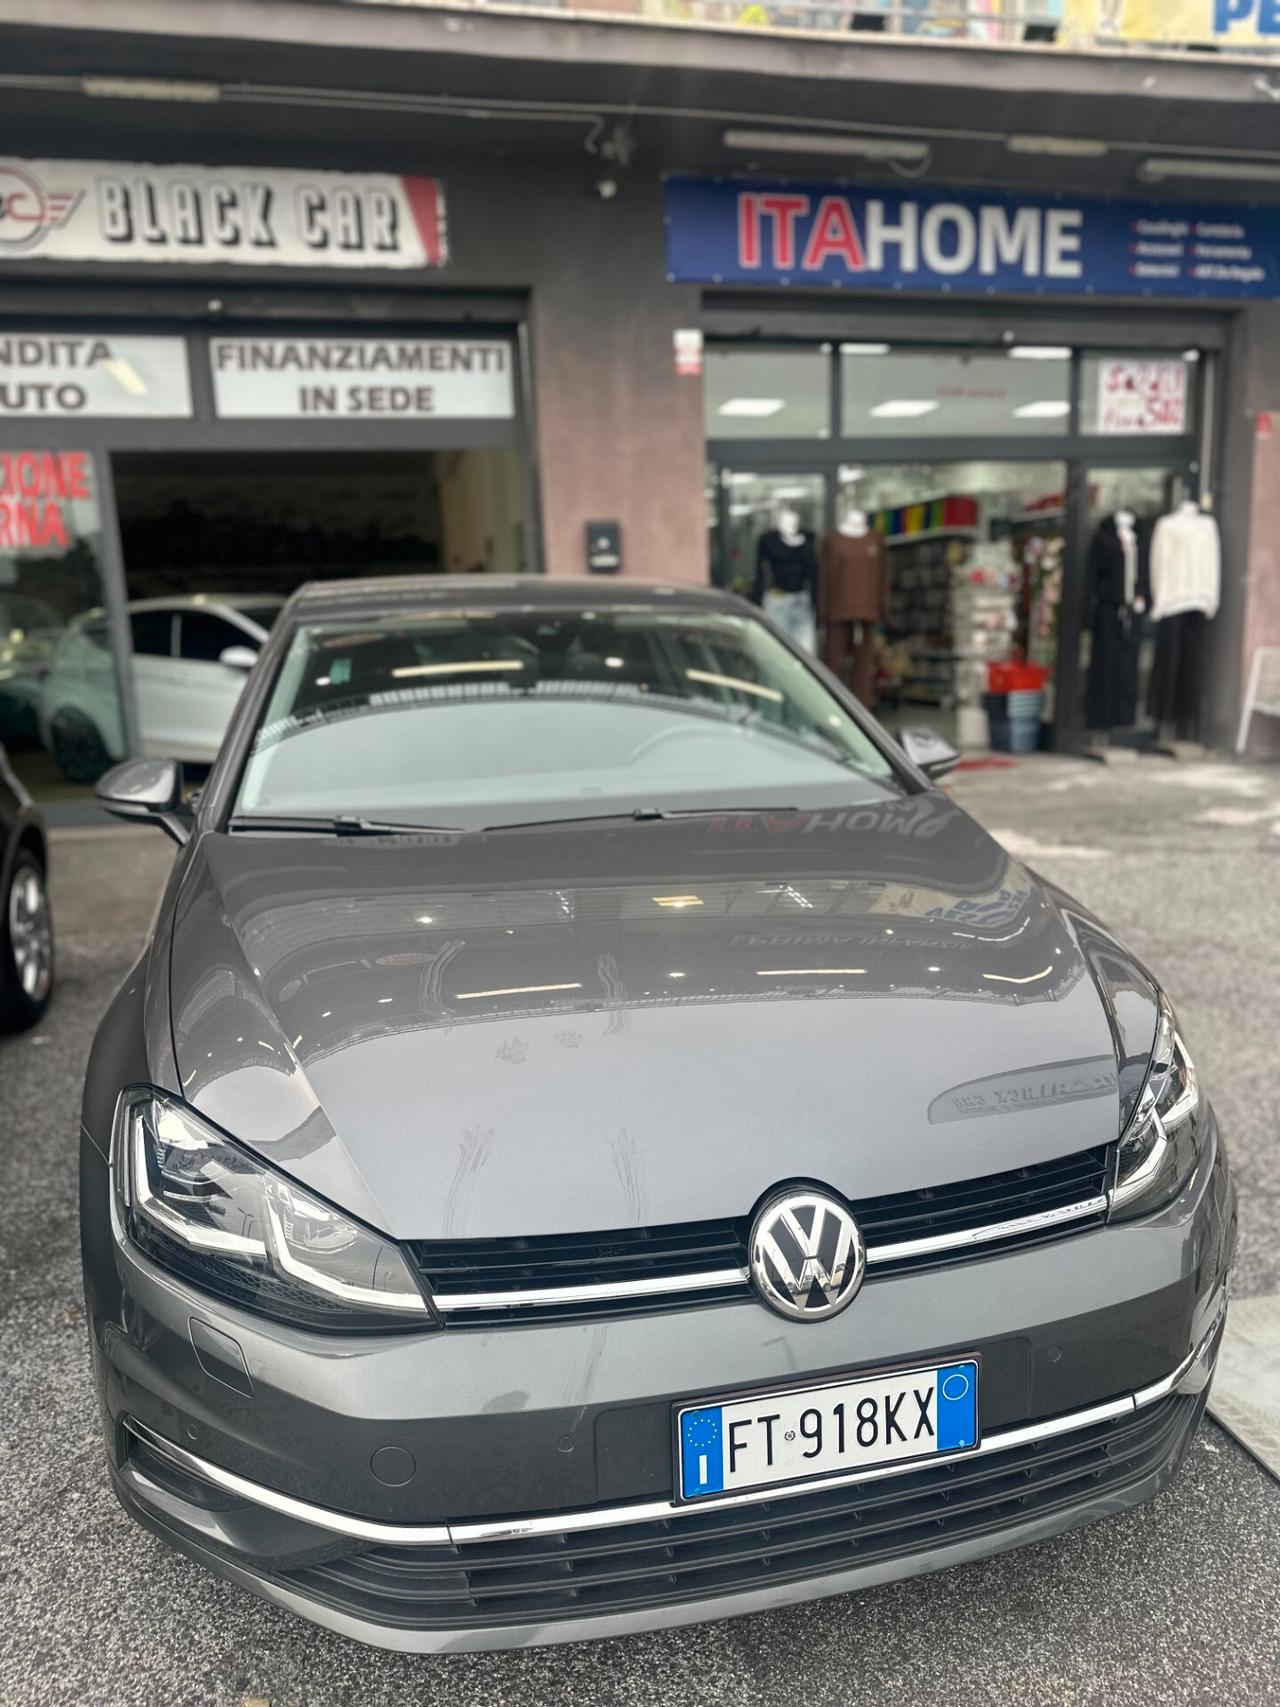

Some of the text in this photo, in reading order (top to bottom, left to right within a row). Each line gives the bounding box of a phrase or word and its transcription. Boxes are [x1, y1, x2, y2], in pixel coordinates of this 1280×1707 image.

[100, 177, 401, 251] BLACK CAR
[738, 191, 1082, 278] ITAHOME
[217, 344, 504, 372] FINANZIAMENTI
[300, 386, 435, 412] IN SEDE
[0, 450, 90, 498] IONE
[728, 1387, 934, 1472] FT 918KX
